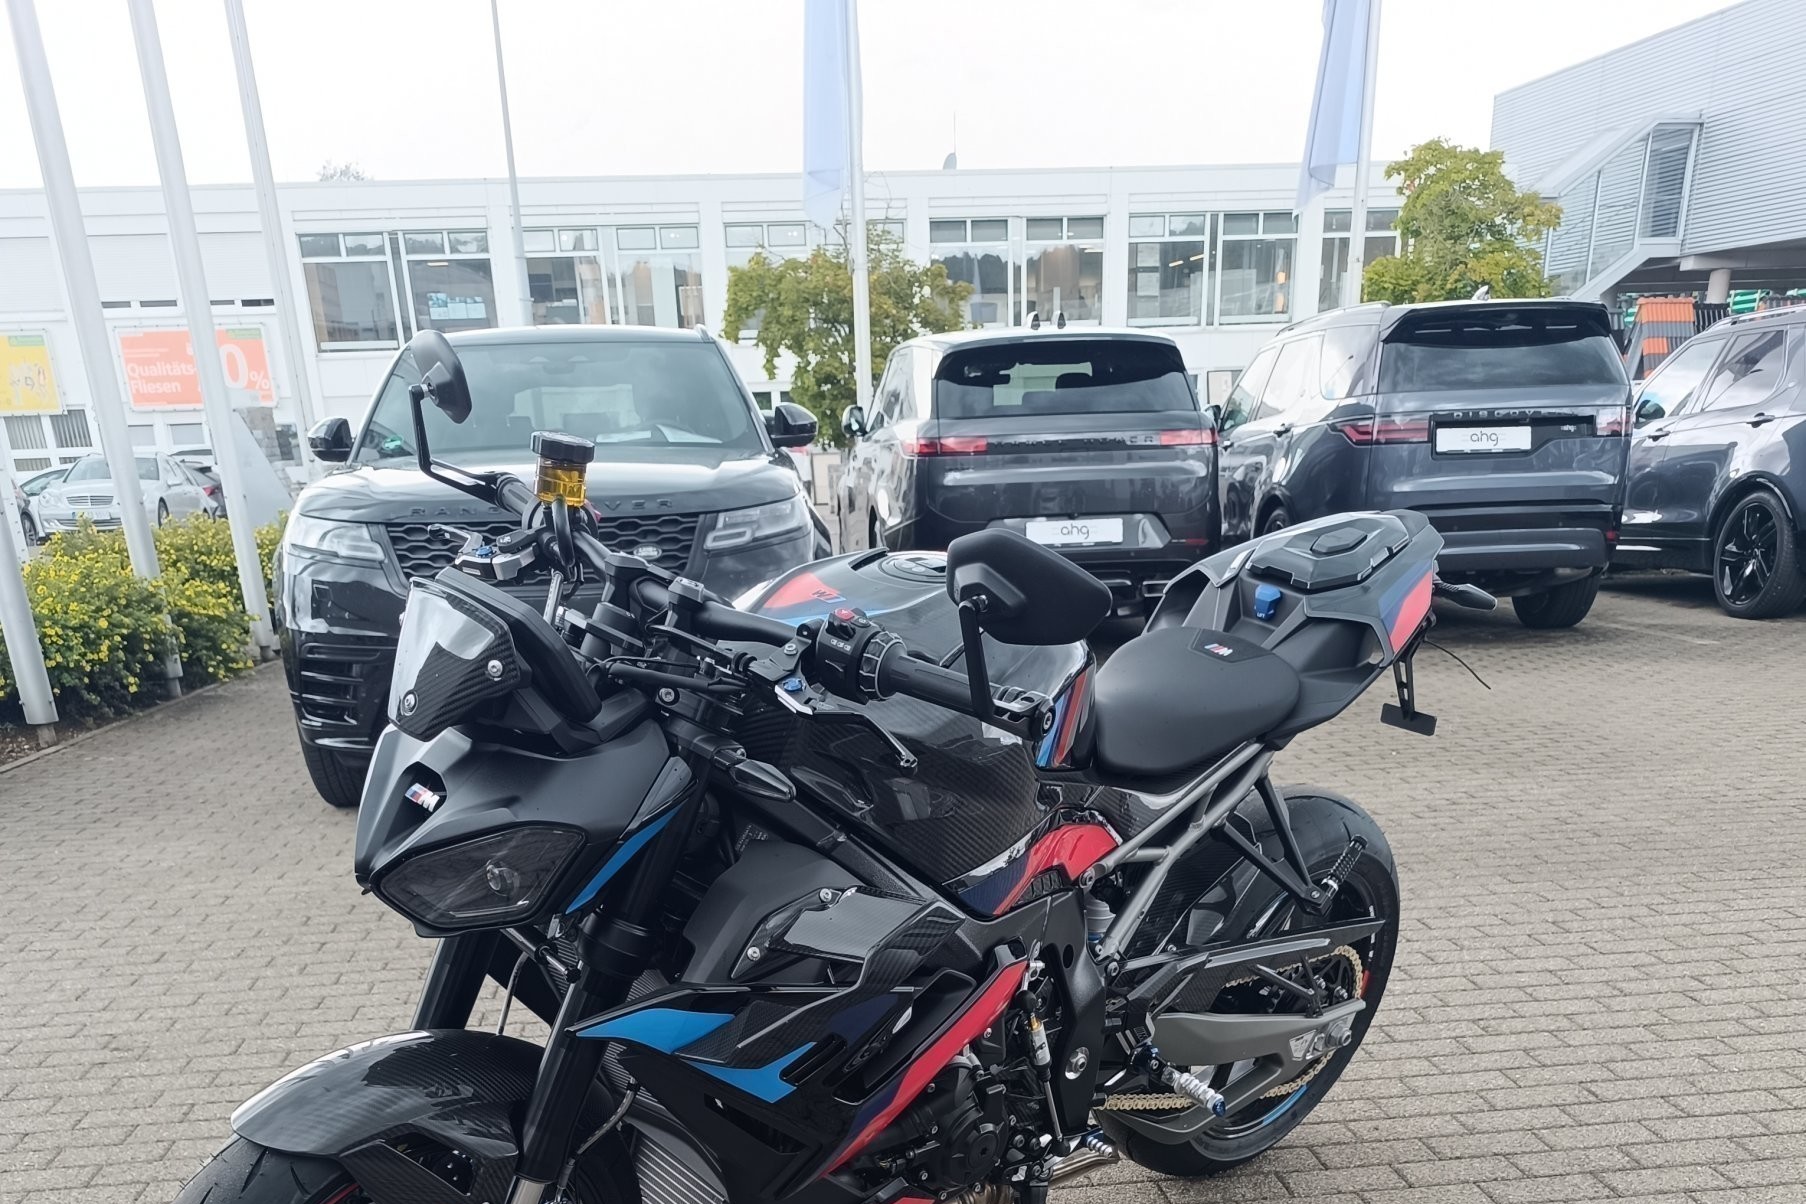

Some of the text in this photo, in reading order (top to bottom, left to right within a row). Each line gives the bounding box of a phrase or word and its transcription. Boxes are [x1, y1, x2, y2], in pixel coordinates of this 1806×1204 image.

[127, 360, 197, 377] Qualitäts-
[187, 342, 271, 390] 0%
[130, 380, 181, 395] Fliesen
[1454, 410, 1549, 418] DISCOV
[1470, 430, 1499, 446] ahg
[410, 499, 673, 517] RANG VER
[1060, 524, 1090, 540] ahg
